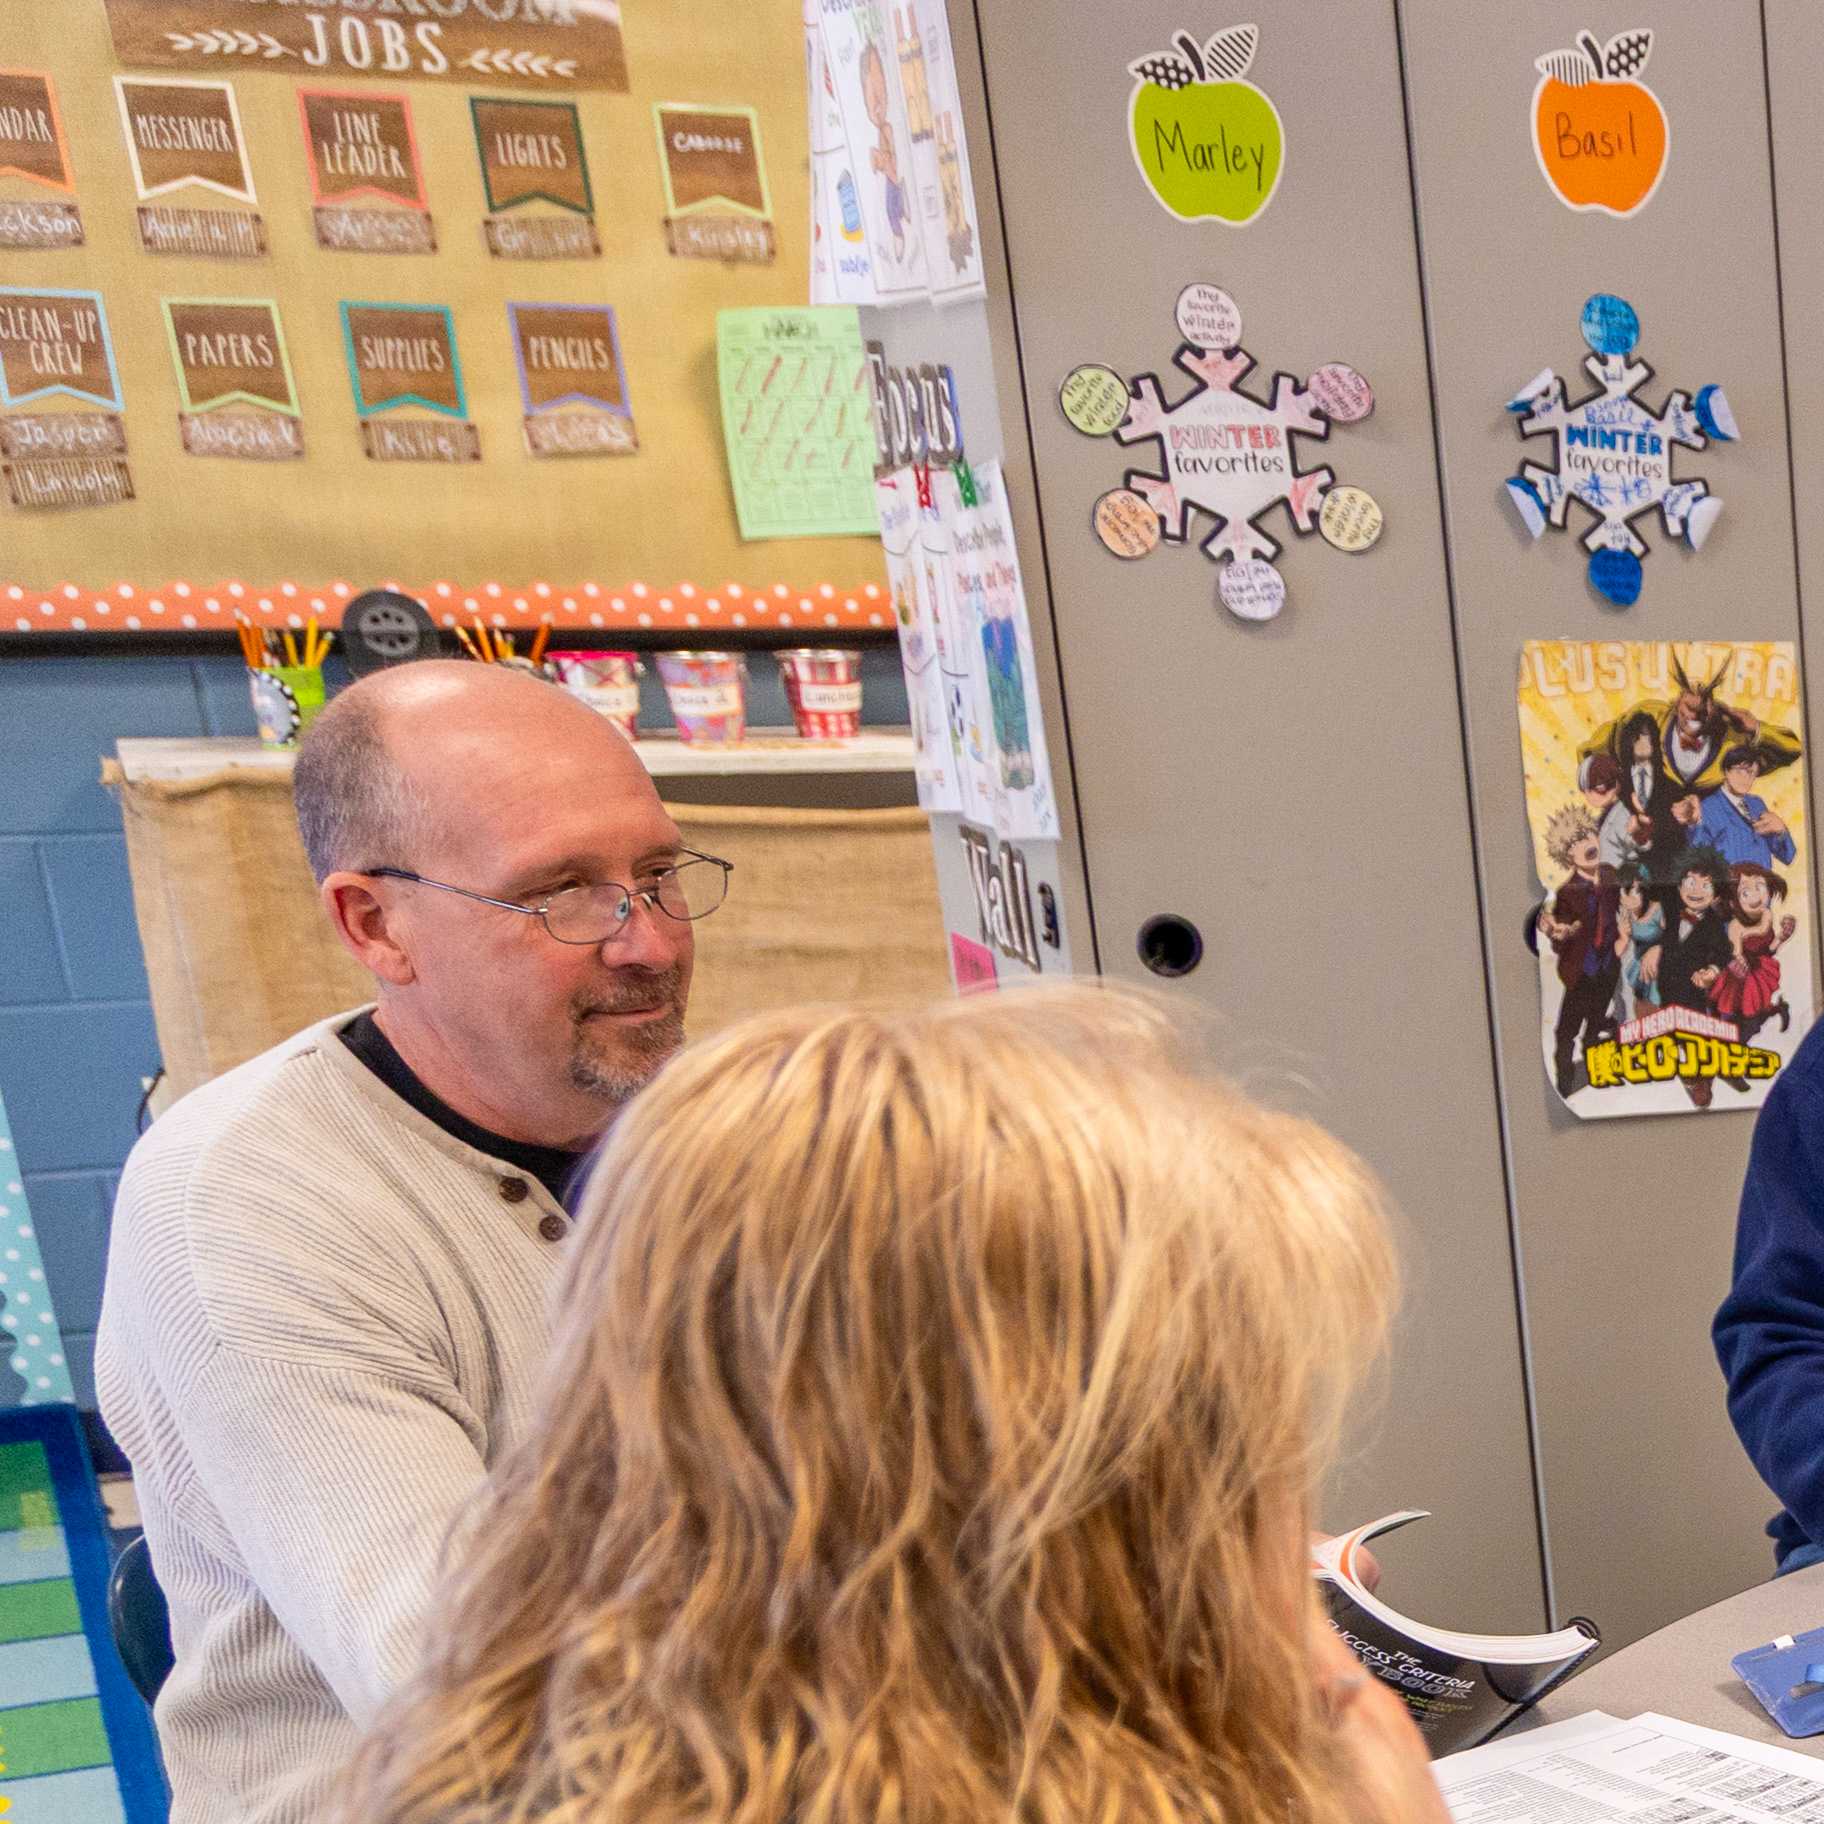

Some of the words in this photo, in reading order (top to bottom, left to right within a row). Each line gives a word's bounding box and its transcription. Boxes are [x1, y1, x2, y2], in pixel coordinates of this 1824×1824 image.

[303, 14, 448, 74] JOBS
[135, 114, 234, 153] MESSENGER
[333, 112, 382, 147] LINE
[1555, 111, 1637, 158] Basil
[322, 140, 407, 179] LEADER
[496, 133, 568, 170] LIGHTS
[1154, 119, 1264, 192] Marley
[29, 341, 84, 375] CREW
[184, 332, 275, 368] PAPERS
[361, 336, 446, 373] SUPPLIES
[528, 336, 611, 371] PENCILS
[1168, 423, 1283, 450] WINTER
[1566, 424, 1663, 456] WINTER
[1174, 450, 1285, 475] favorites
[1566, 447, 1664, 480] favorites
[1395, 1650, 1423, 1666] THE
[1398, 1664, 1475, 1689] CRITERIA
